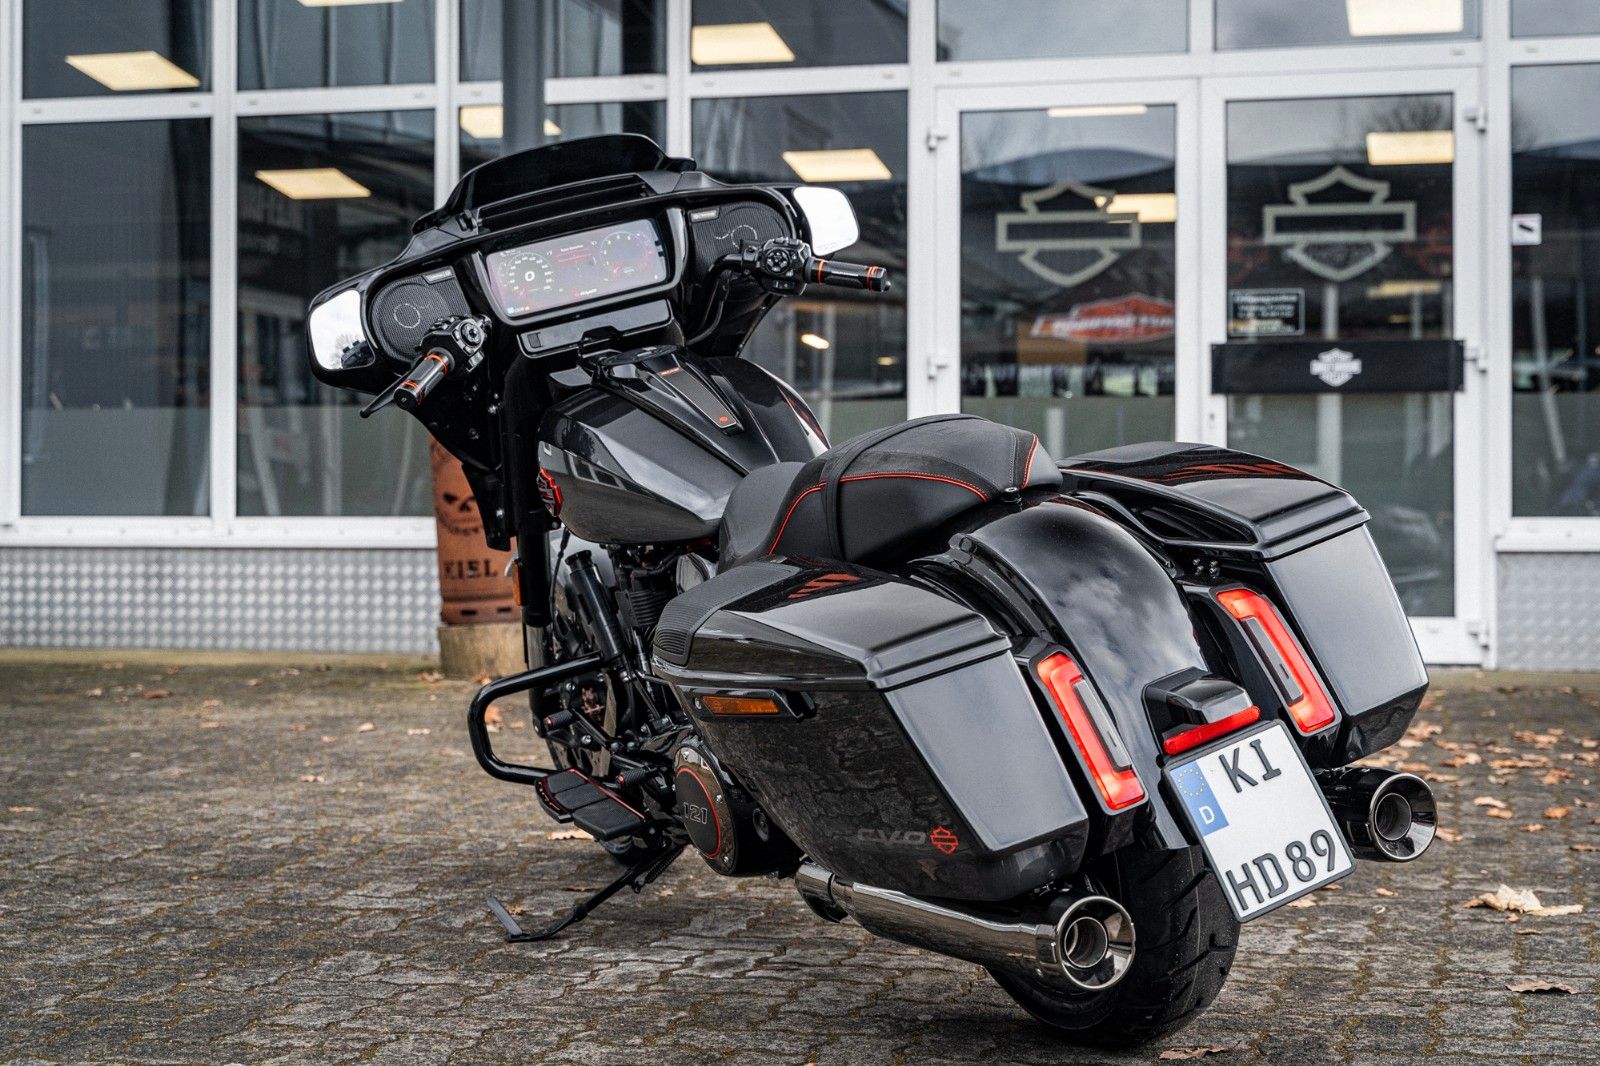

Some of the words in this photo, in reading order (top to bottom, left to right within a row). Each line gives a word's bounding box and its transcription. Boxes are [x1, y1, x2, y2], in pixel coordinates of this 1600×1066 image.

[1218, 738, 1282, 793] KI
[683, 802, 708, 825] 121
[1199, 805, 1215, 825] D
[857, 828, 927, 846] CVO
